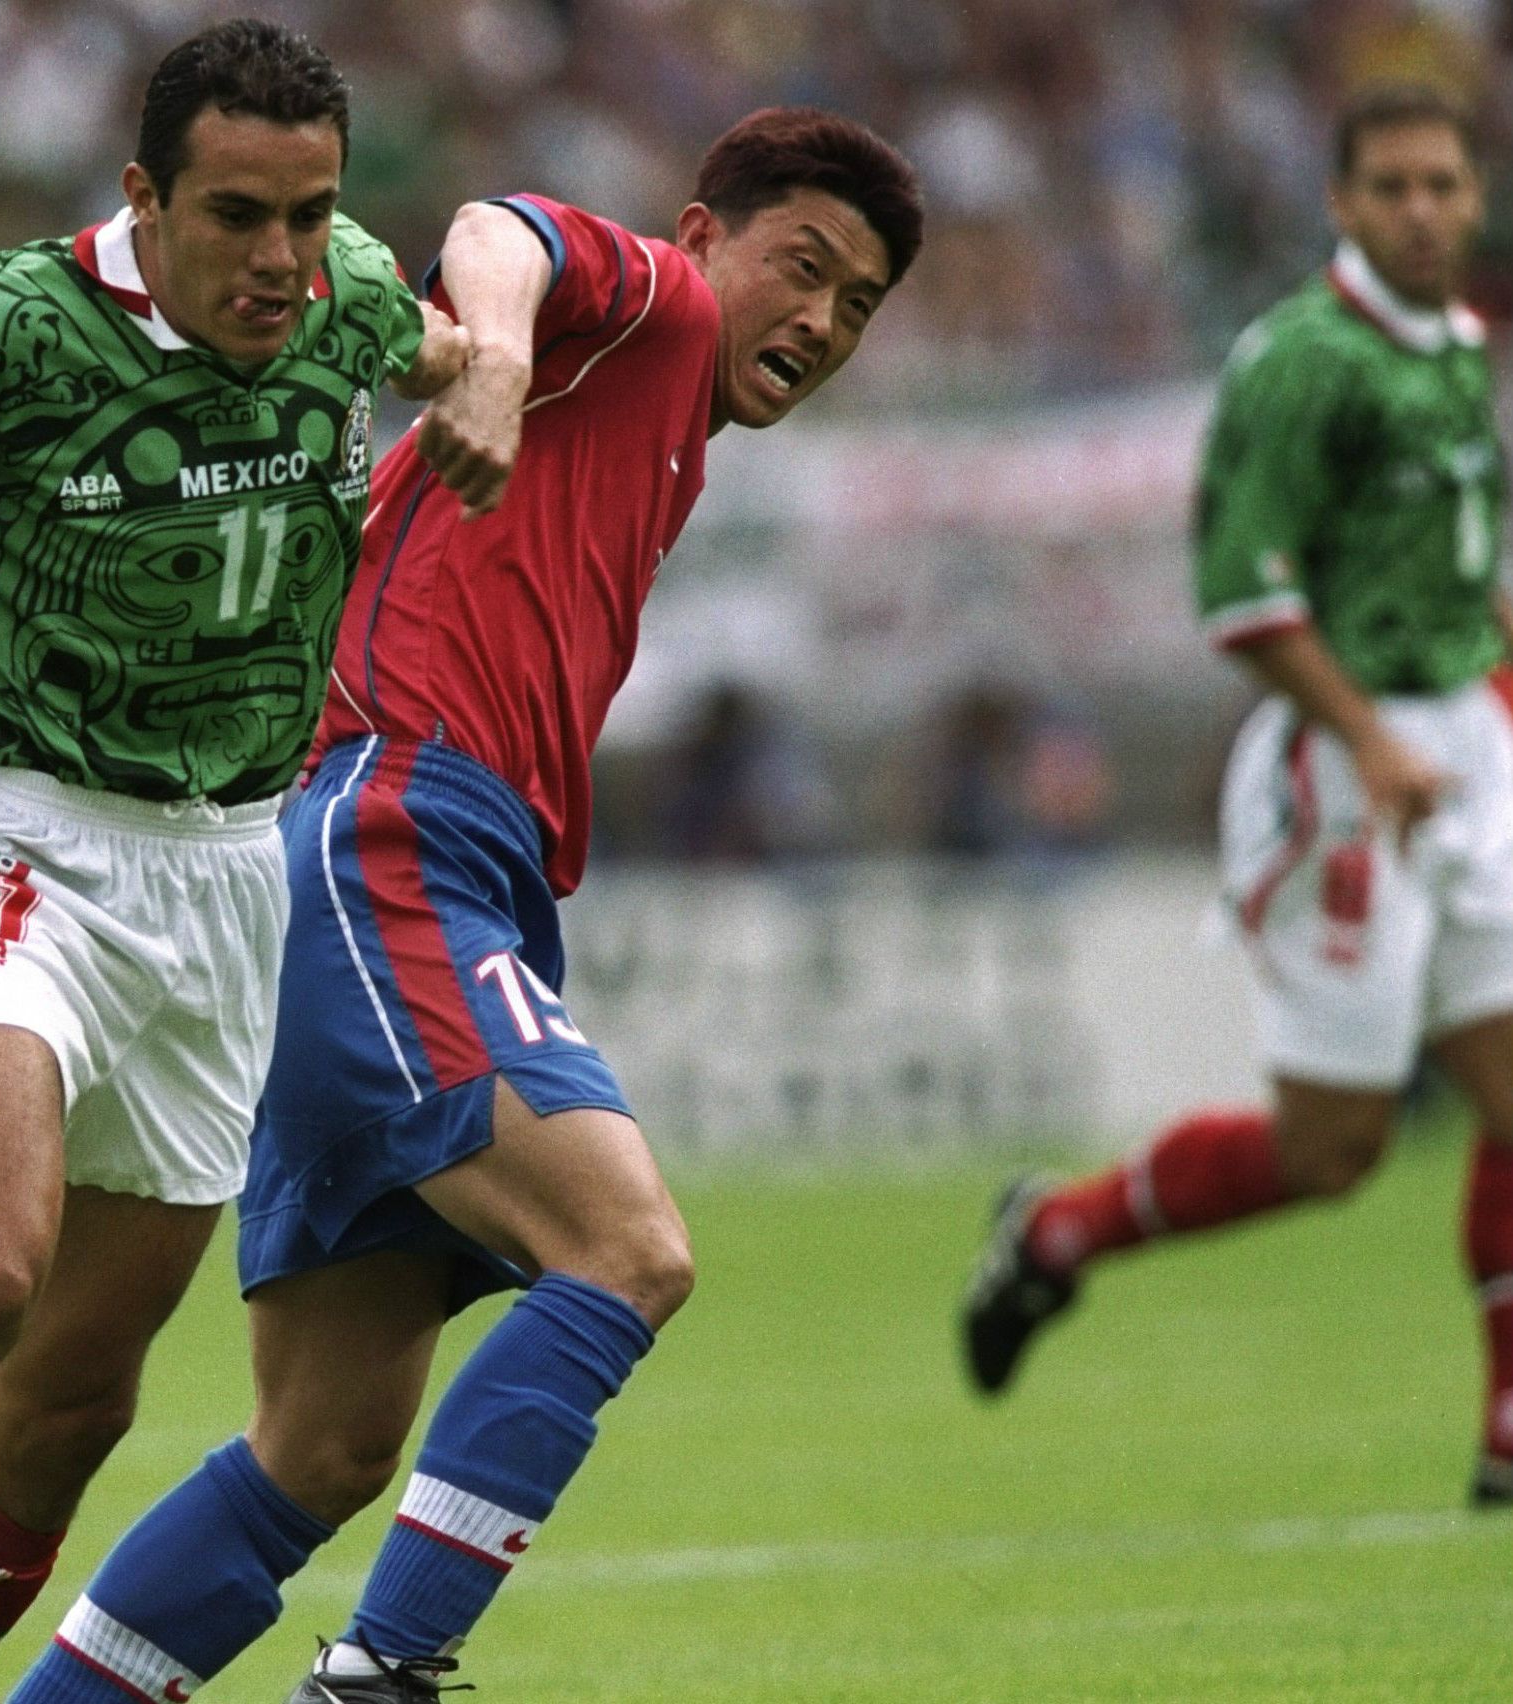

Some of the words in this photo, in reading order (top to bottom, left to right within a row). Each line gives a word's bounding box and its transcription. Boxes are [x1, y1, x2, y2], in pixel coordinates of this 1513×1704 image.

[59, 473, 121, 497] ABA
[179, 450, 309, 499] MEXICO
[61, 495, 123, 512] SPORT
[217, 502, 287, 622] 11
